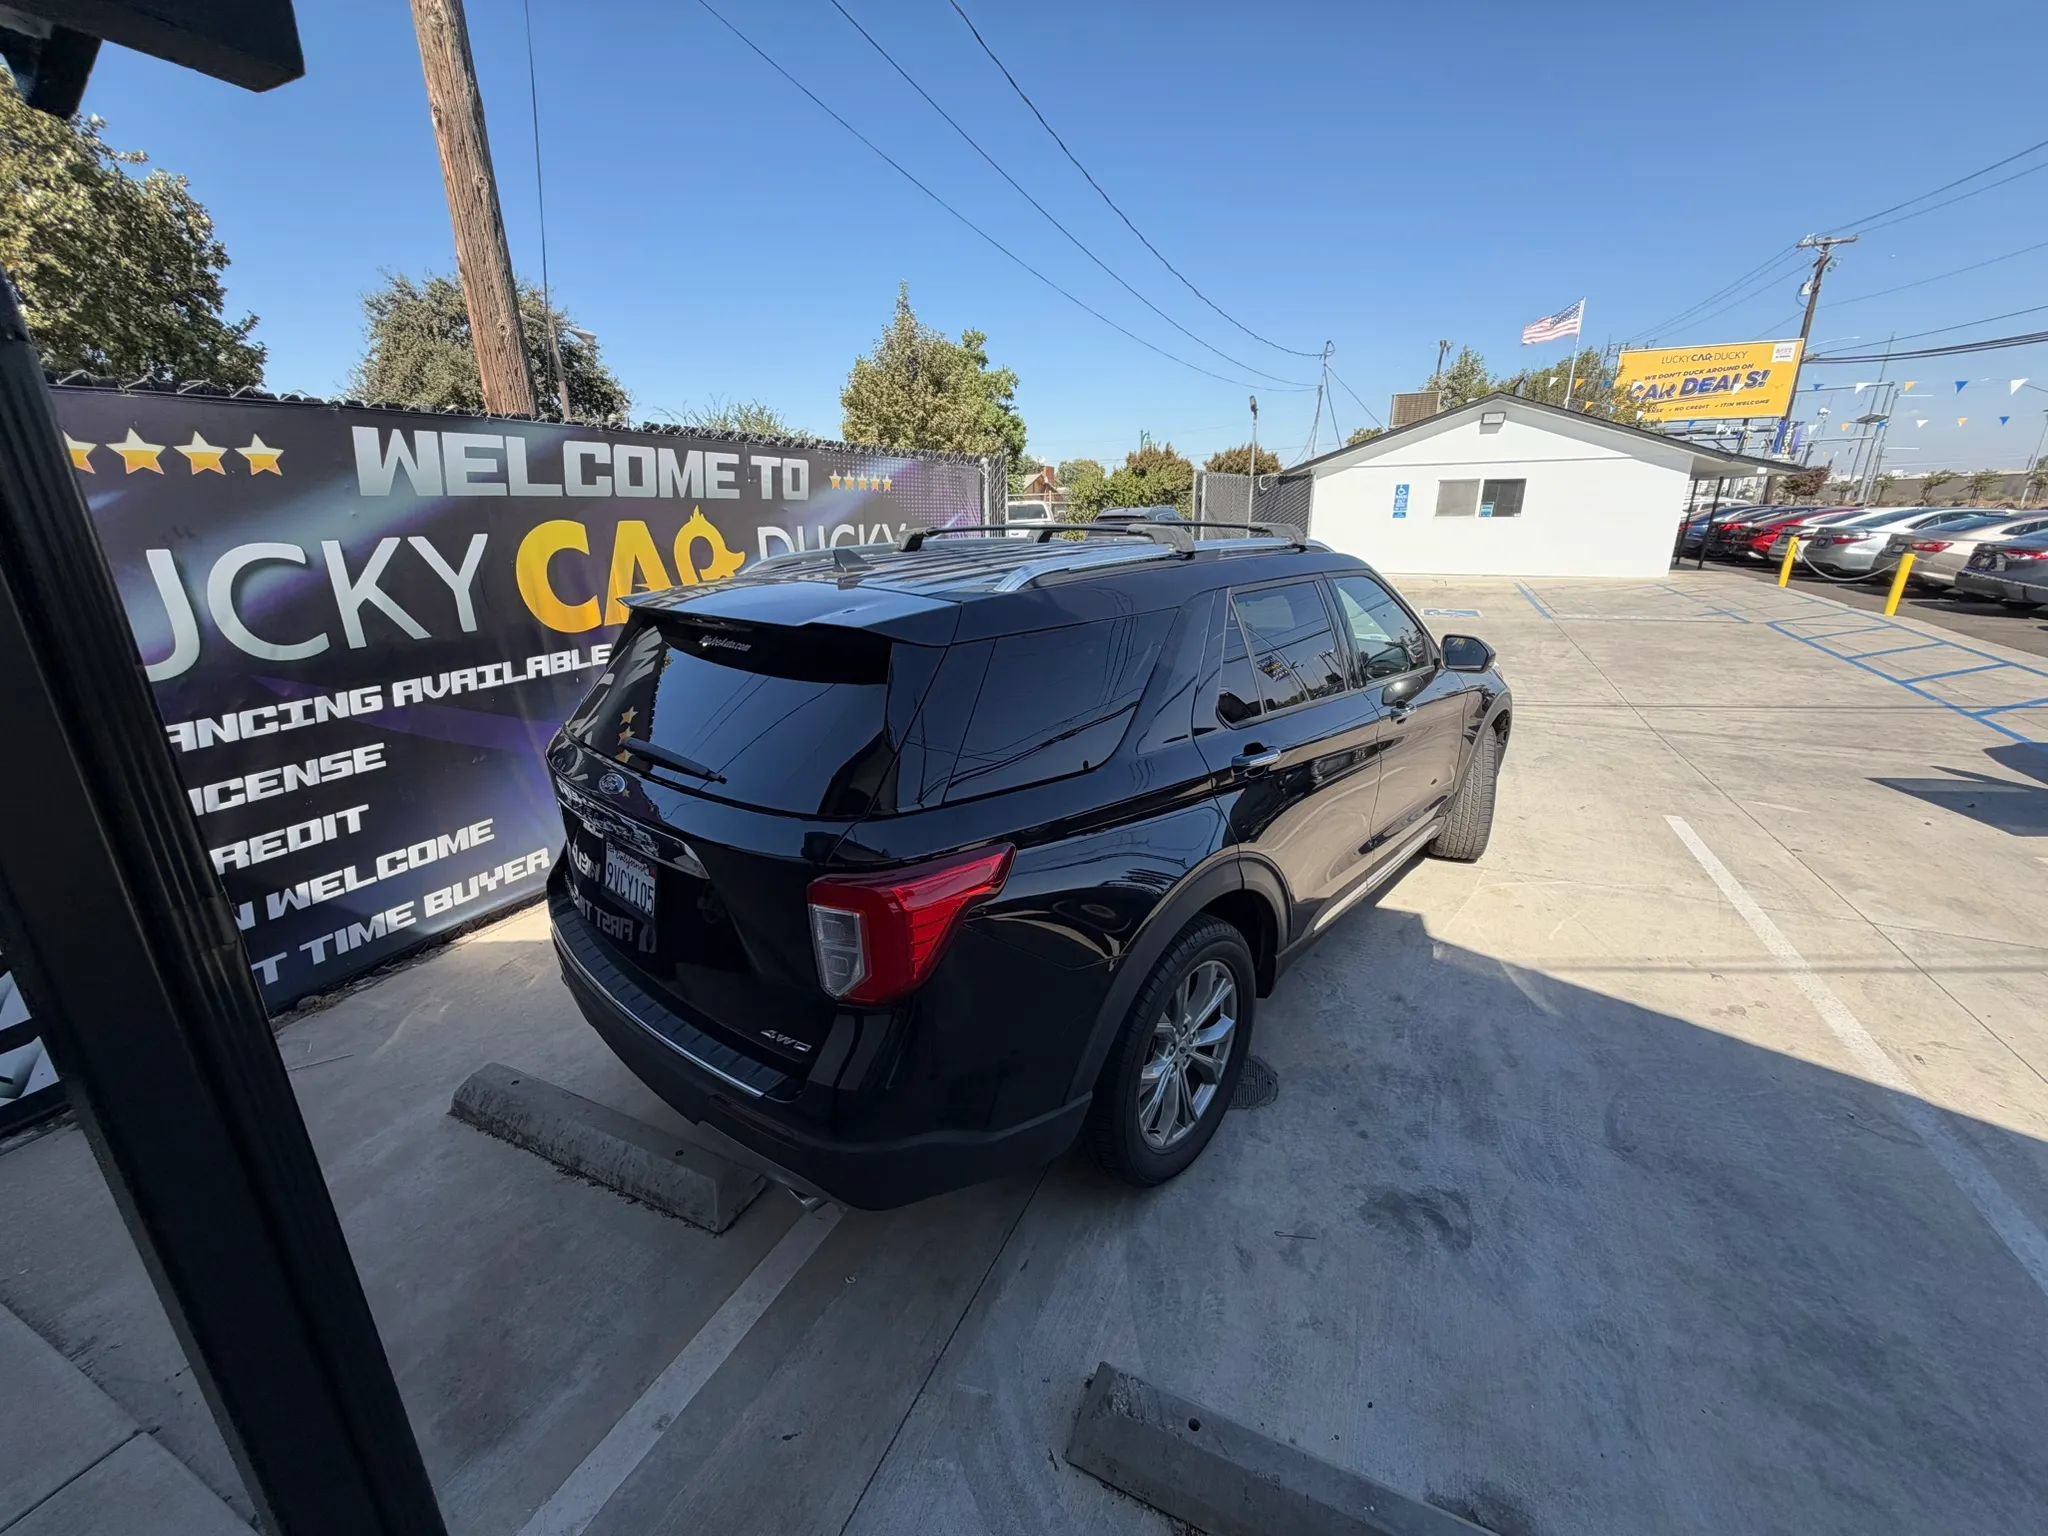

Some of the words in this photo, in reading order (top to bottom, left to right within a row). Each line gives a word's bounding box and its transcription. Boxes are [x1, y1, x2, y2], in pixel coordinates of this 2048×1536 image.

[1658, 371, 1681, 379] DON'T
[1682, 368, 1705, 377] DUCK
[1706, 365, 1740, 373] AROUND
[1661, 354, 1691, 365] LUCKY
[1714, 351, 1748, 361] DUCKY
[352, 425, 740, 499] WELCOME
[751, 455, 810, 500] TO
[165, 685, 384, 752] ANCING
[392, 643, 613, 708] AVAILABLE
[188, 742, 387, 816] ICENSE
[209, 803, 369, 875] REDIT
[266, 818, 495, 920] WELCOME
[299, 900, 417, 965] TIME
[424, 847, 551, 918] BUYER
[606, 862, 655, 915] 9VCY105
